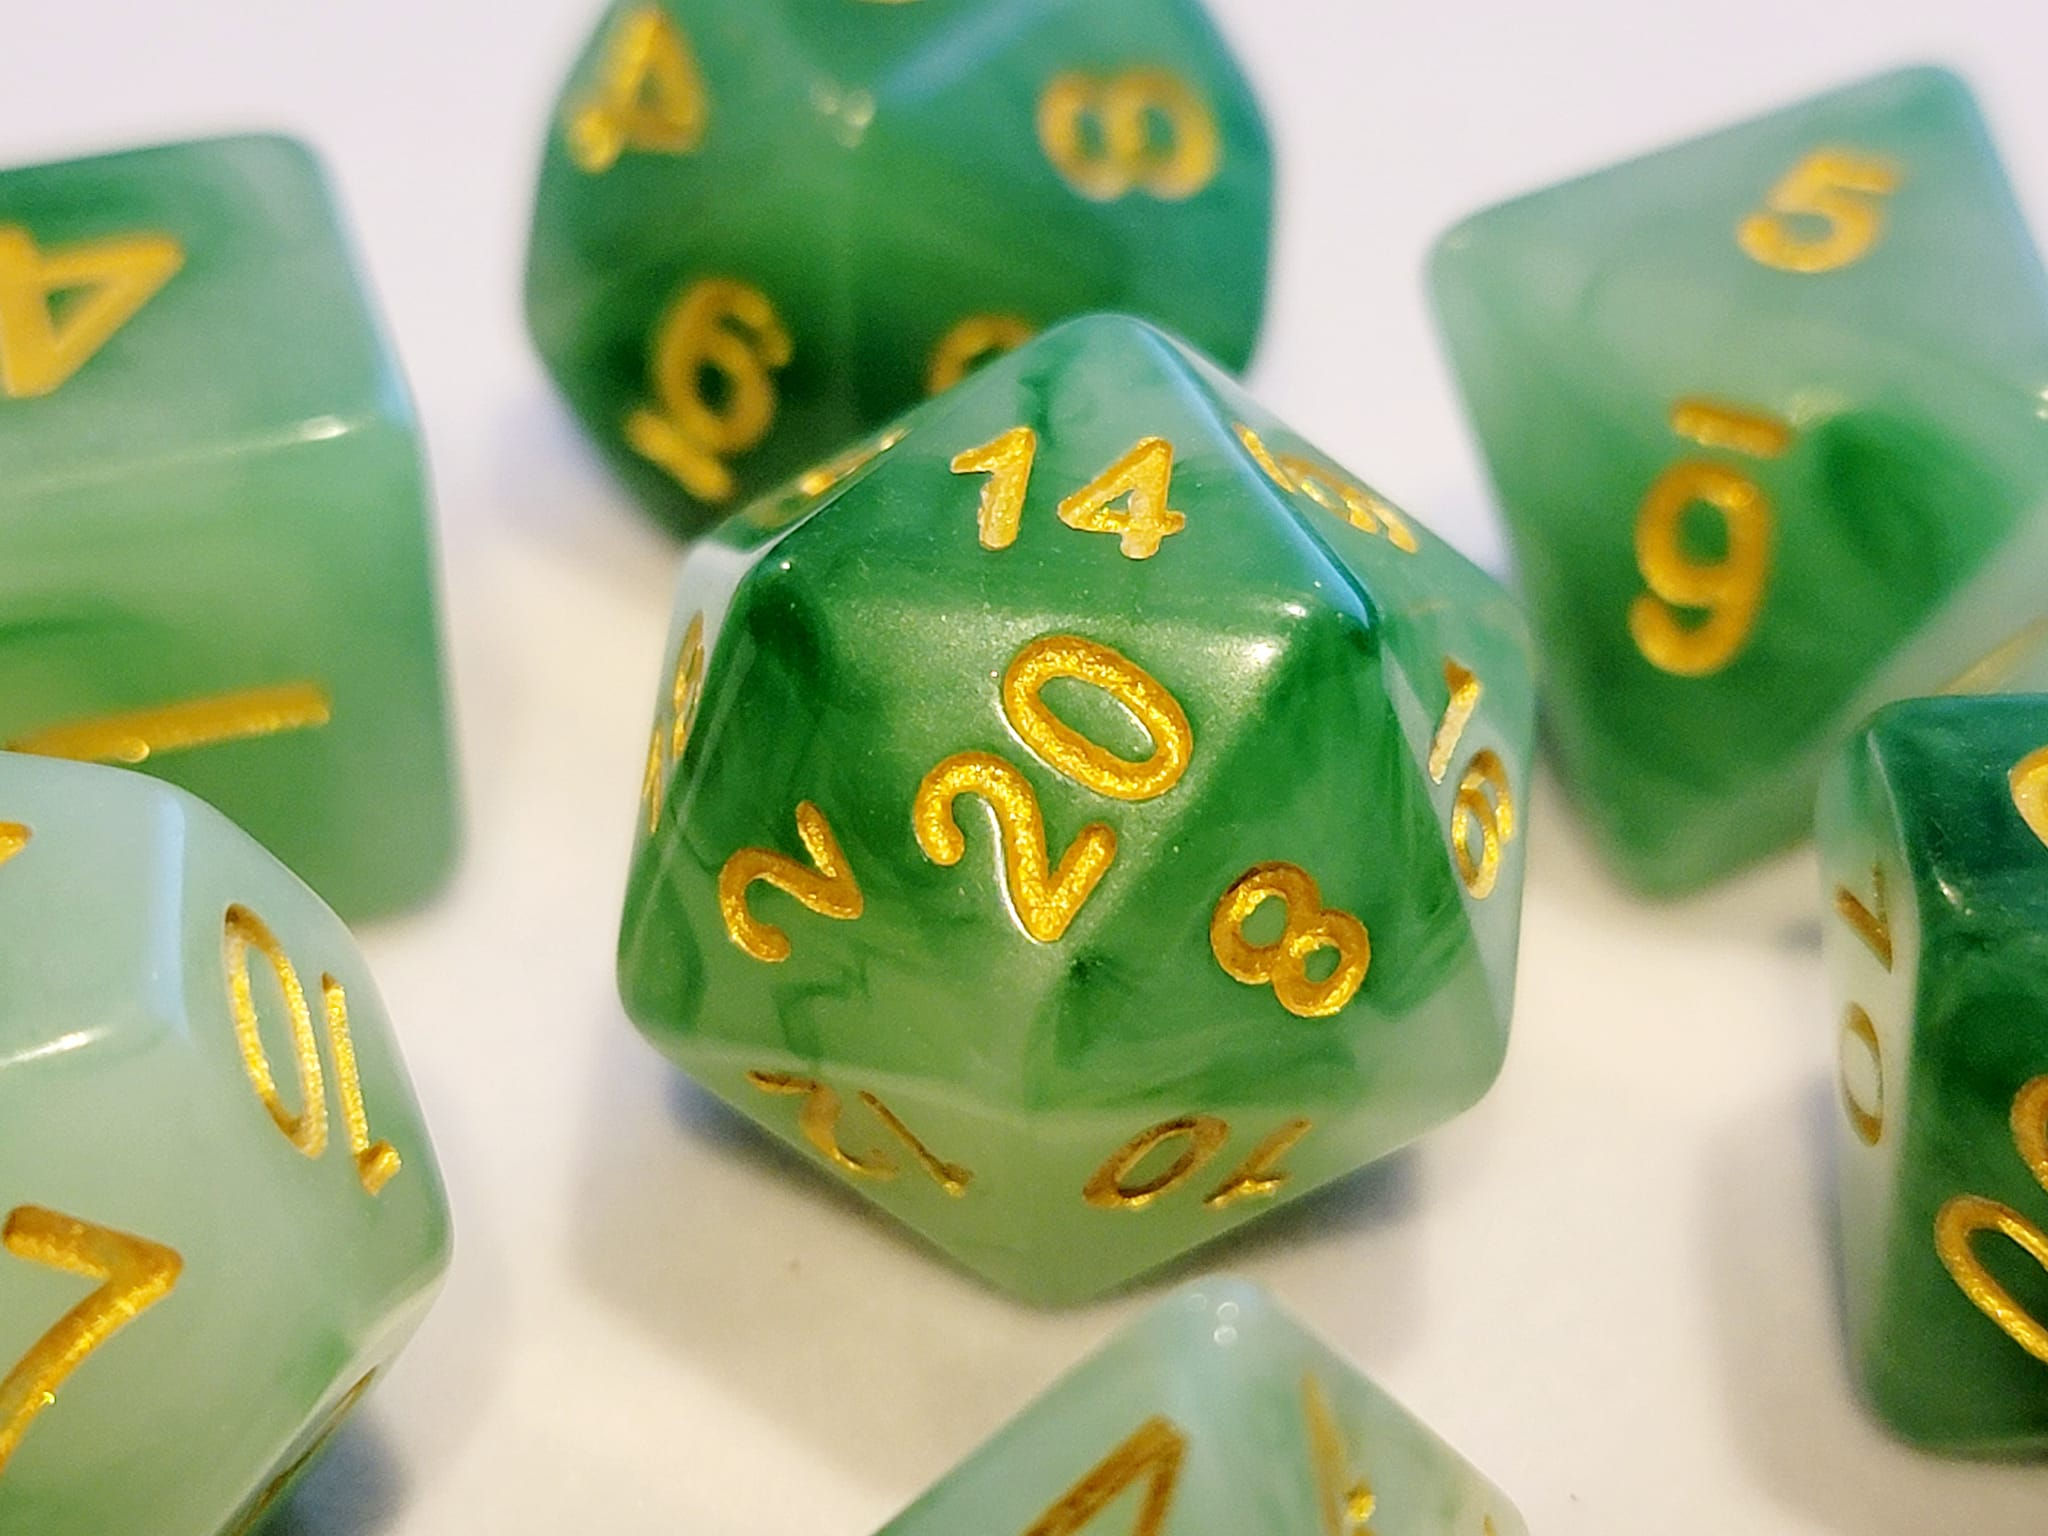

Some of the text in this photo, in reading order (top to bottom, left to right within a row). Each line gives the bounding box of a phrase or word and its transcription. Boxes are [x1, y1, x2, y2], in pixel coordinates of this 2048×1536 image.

[1040, 70, 1216, 198] 8
[1740, 150, 1896, 273] 5
[948, 425, 1187, 561] 14
[912, 635, 1194, 945] 20
[718, 801, 865, 964] 2
[1209, 860, 1371, 1018] 8
